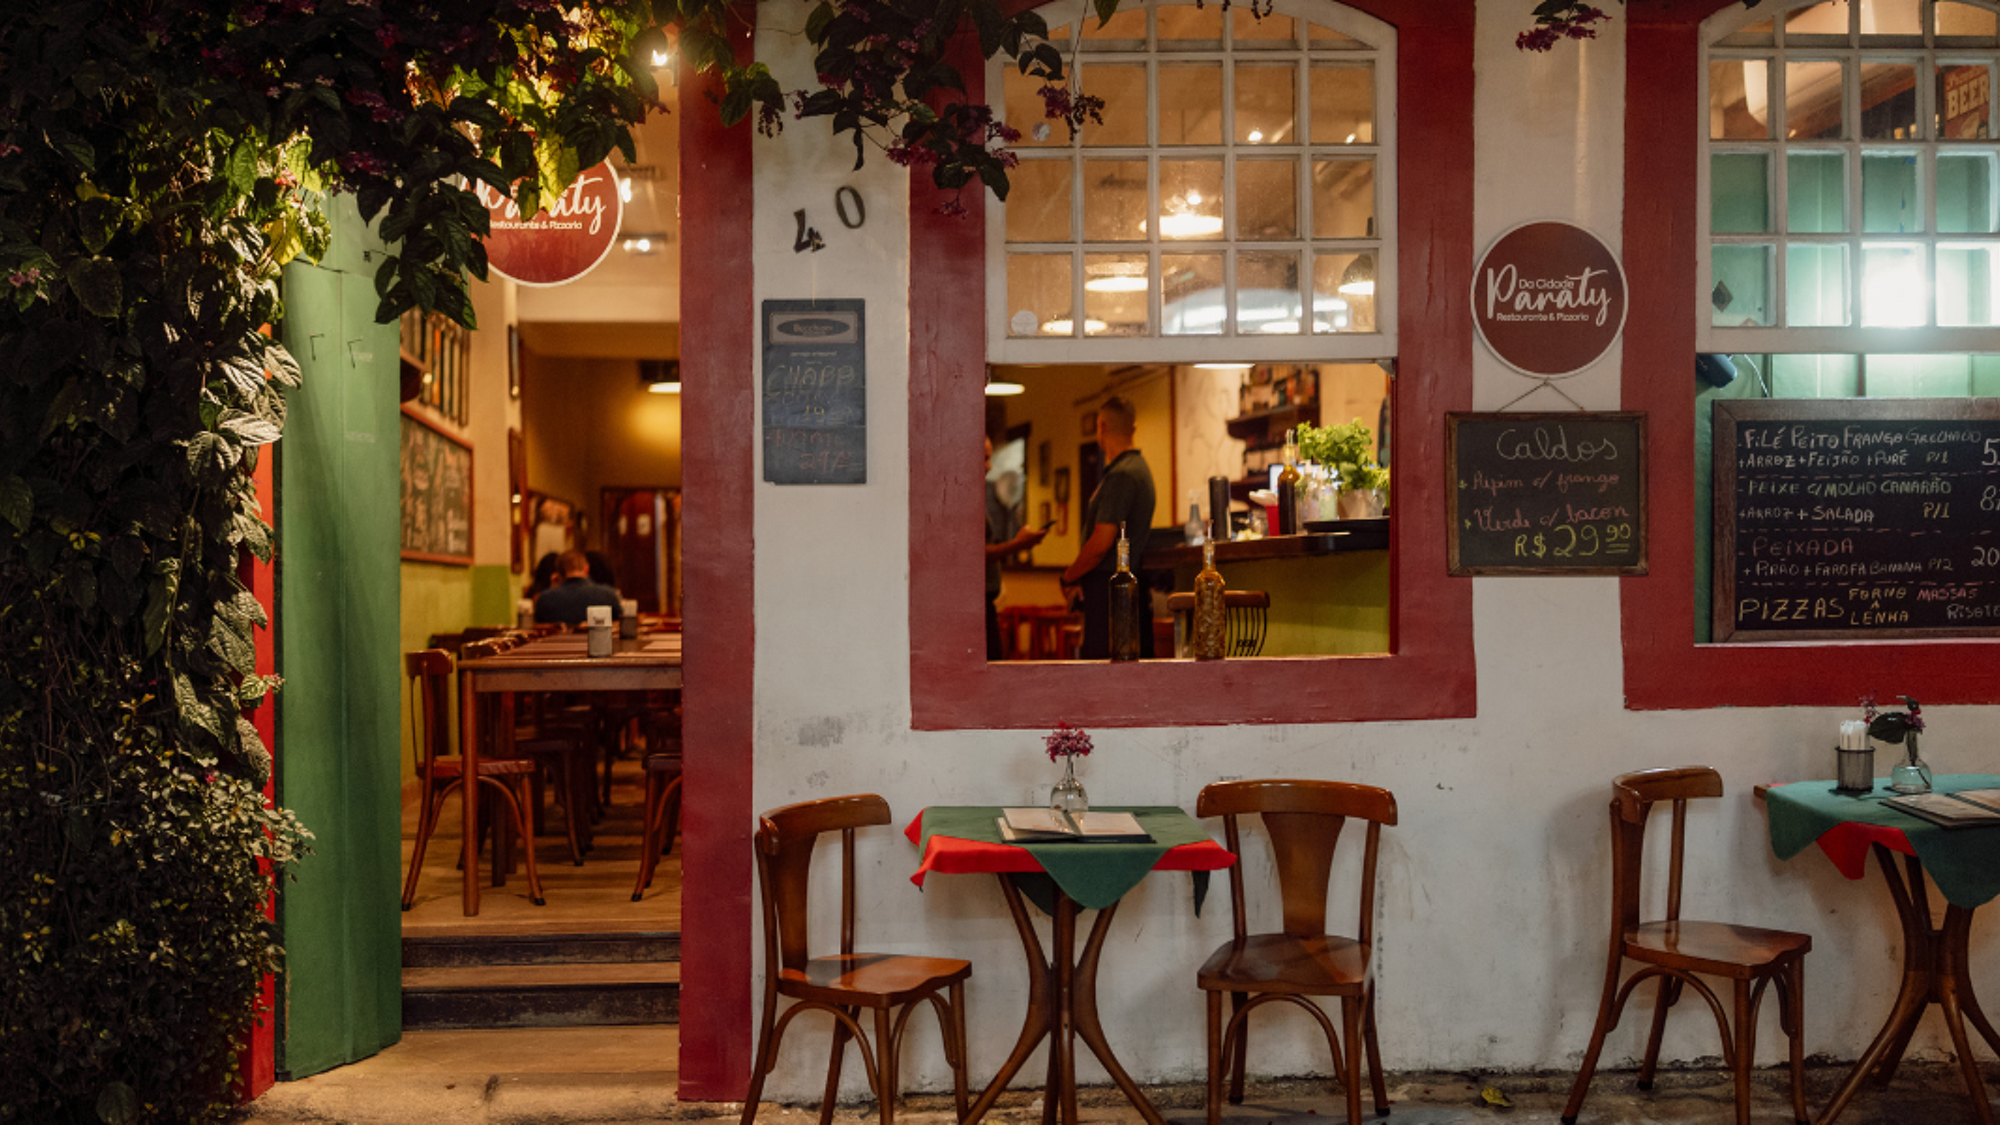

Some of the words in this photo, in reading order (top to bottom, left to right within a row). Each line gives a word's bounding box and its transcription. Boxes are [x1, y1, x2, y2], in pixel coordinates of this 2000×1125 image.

[1947, 74, 1989, 120] BEER
[793, 185, 866, 254] 40
[1486, 263, 1612, 327] Paraty
[1518, 278, 1535, 290] Da
[1536, 278, 1575, 290] Cidade
[1496, 312, 1548, 322] Restaurante
[1556, 312, 1590, 322] Pizzaria
[1496, 424, 1618, 462] Caldos
[1981, 438, 2000, 467] 5
[1557, 471, 1620, 494] frango
[1473, 504, 1531, 532] Verde
[1565, 502, 1630, 524] bacon
[1848, 587, 1907, 601] FORNO
[1917, 587, 1979, 602] MASSAS
[1850, 610, 1909, 626] LENHA
